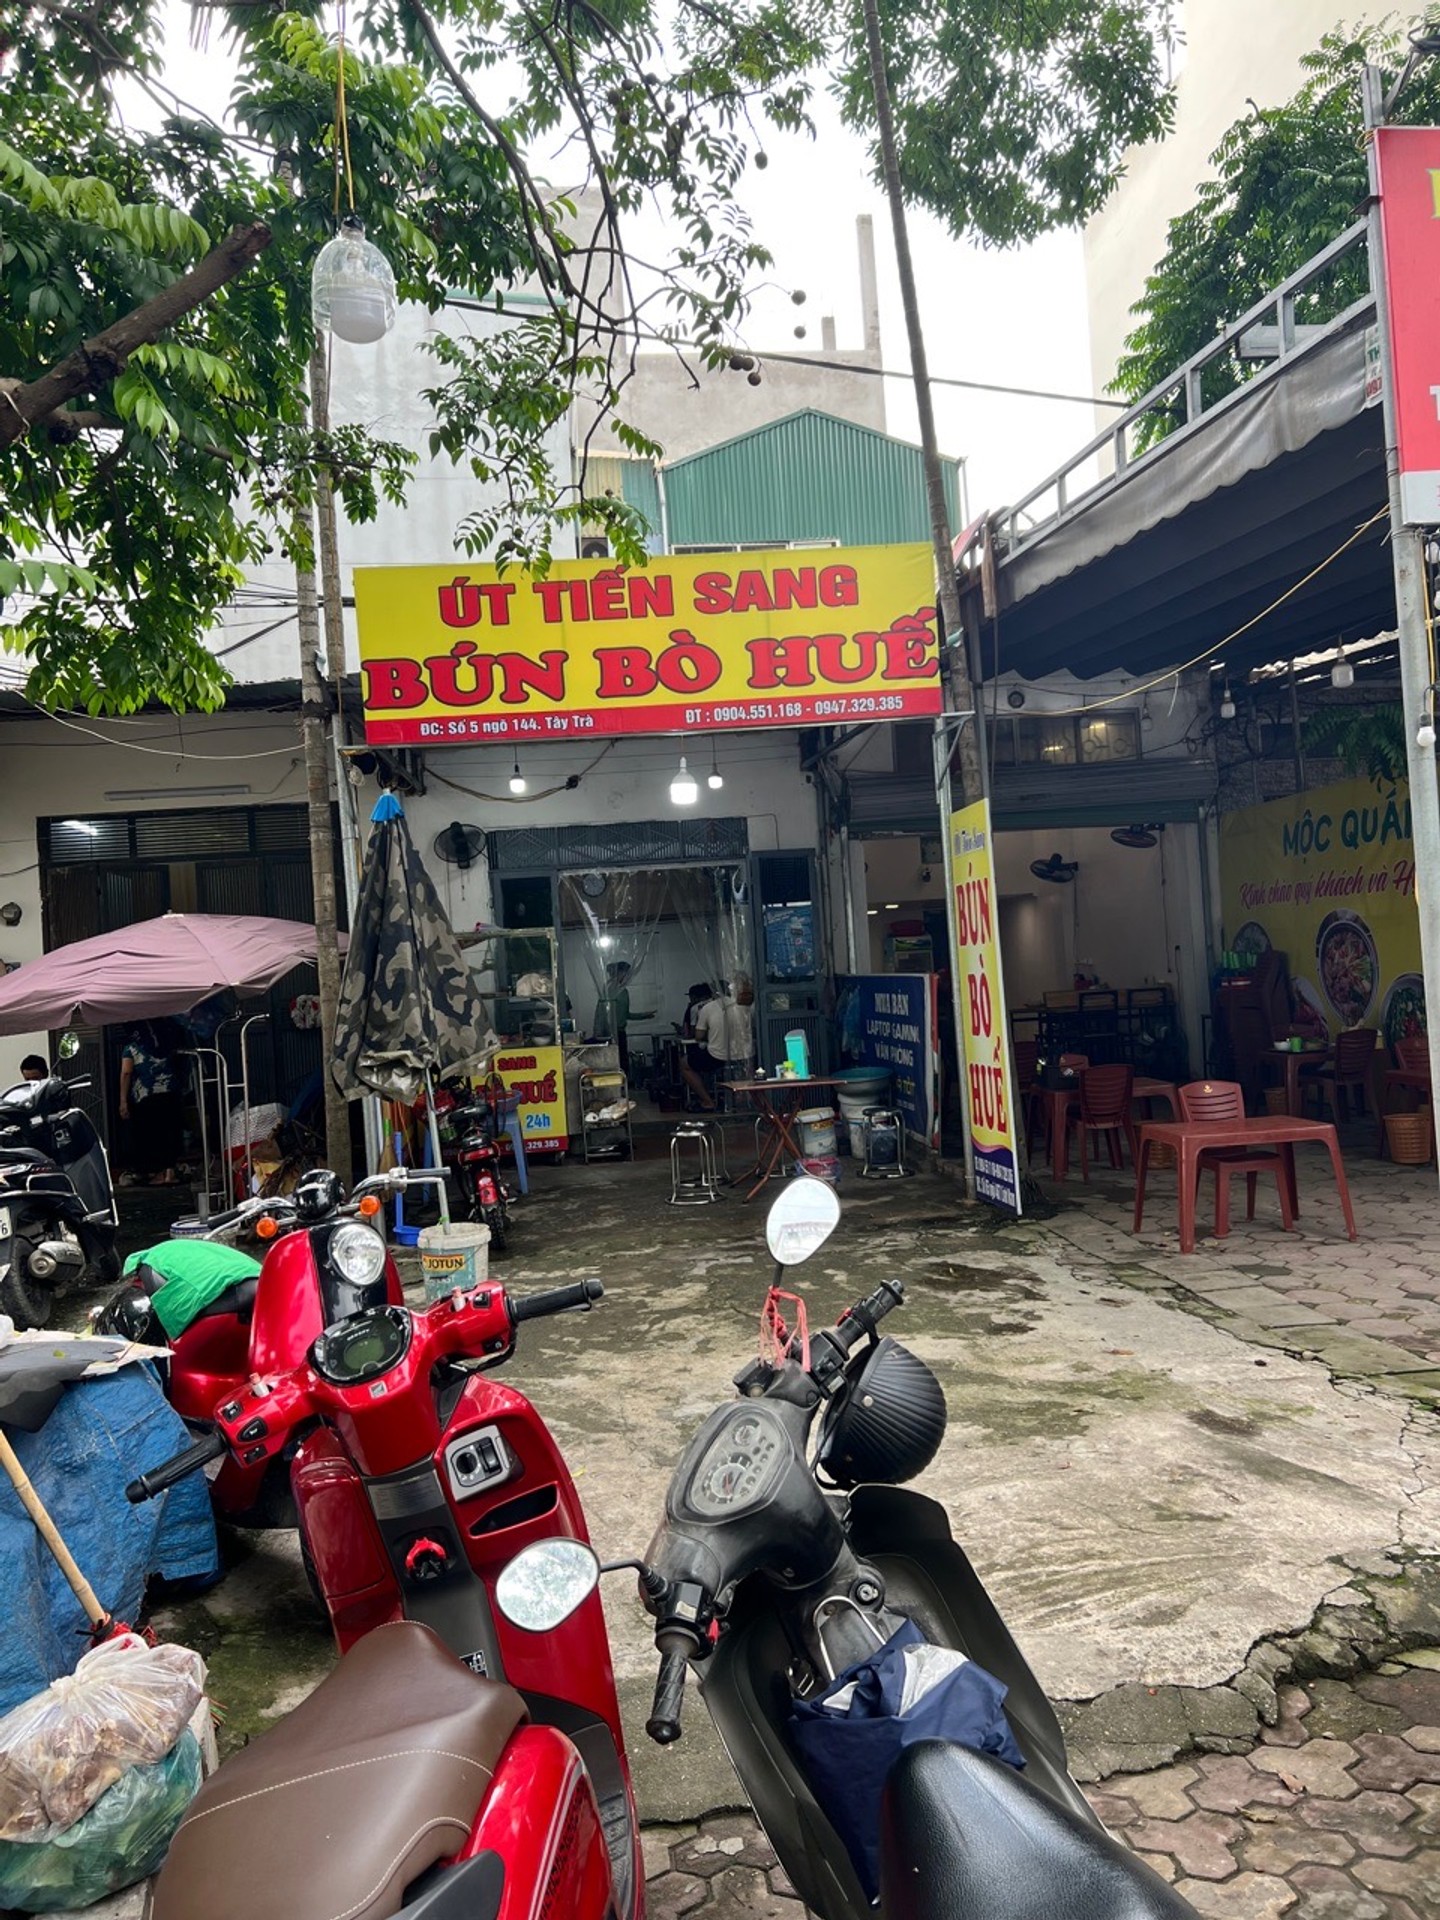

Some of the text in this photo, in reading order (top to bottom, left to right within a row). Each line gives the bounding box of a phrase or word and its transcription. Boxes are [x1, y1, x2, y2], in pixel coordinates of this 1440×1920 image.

[438, 564, 859, 627] ÚT TIẾN SANG
[361, 606, 940, 710] BÚN BÒ HUẾ
[420, 722, 444, 736] ĐC:
[448, 719, 466, 734] Số
[470, 721, 478, 733] 5
[512, 718, 541, 731] 144.
[545, 715, 568, 730] Tây
[572, 714, 593, 729] Trà
[713, 702, 801, 722] 0904.551.168
[815, 696, 903, 715] 0947.329.385
[1283, 809, 1332, 864] MỘC
[1314, 866, 1364, 897] khách
[1367, 864, 1389, 893] và
[956, 862, 992, 946] BÚN
[968, 953, 992, 1037] BÒ
[866, 1019, 891, 1037] LAPTOP
[497, 1056, 537, 1071] SANG
[970, 1035, 1007, 1133] HUẾ
[526, 1113, 551, 1129] 24h
[427, 1257, 464, 1269] JOTUN
